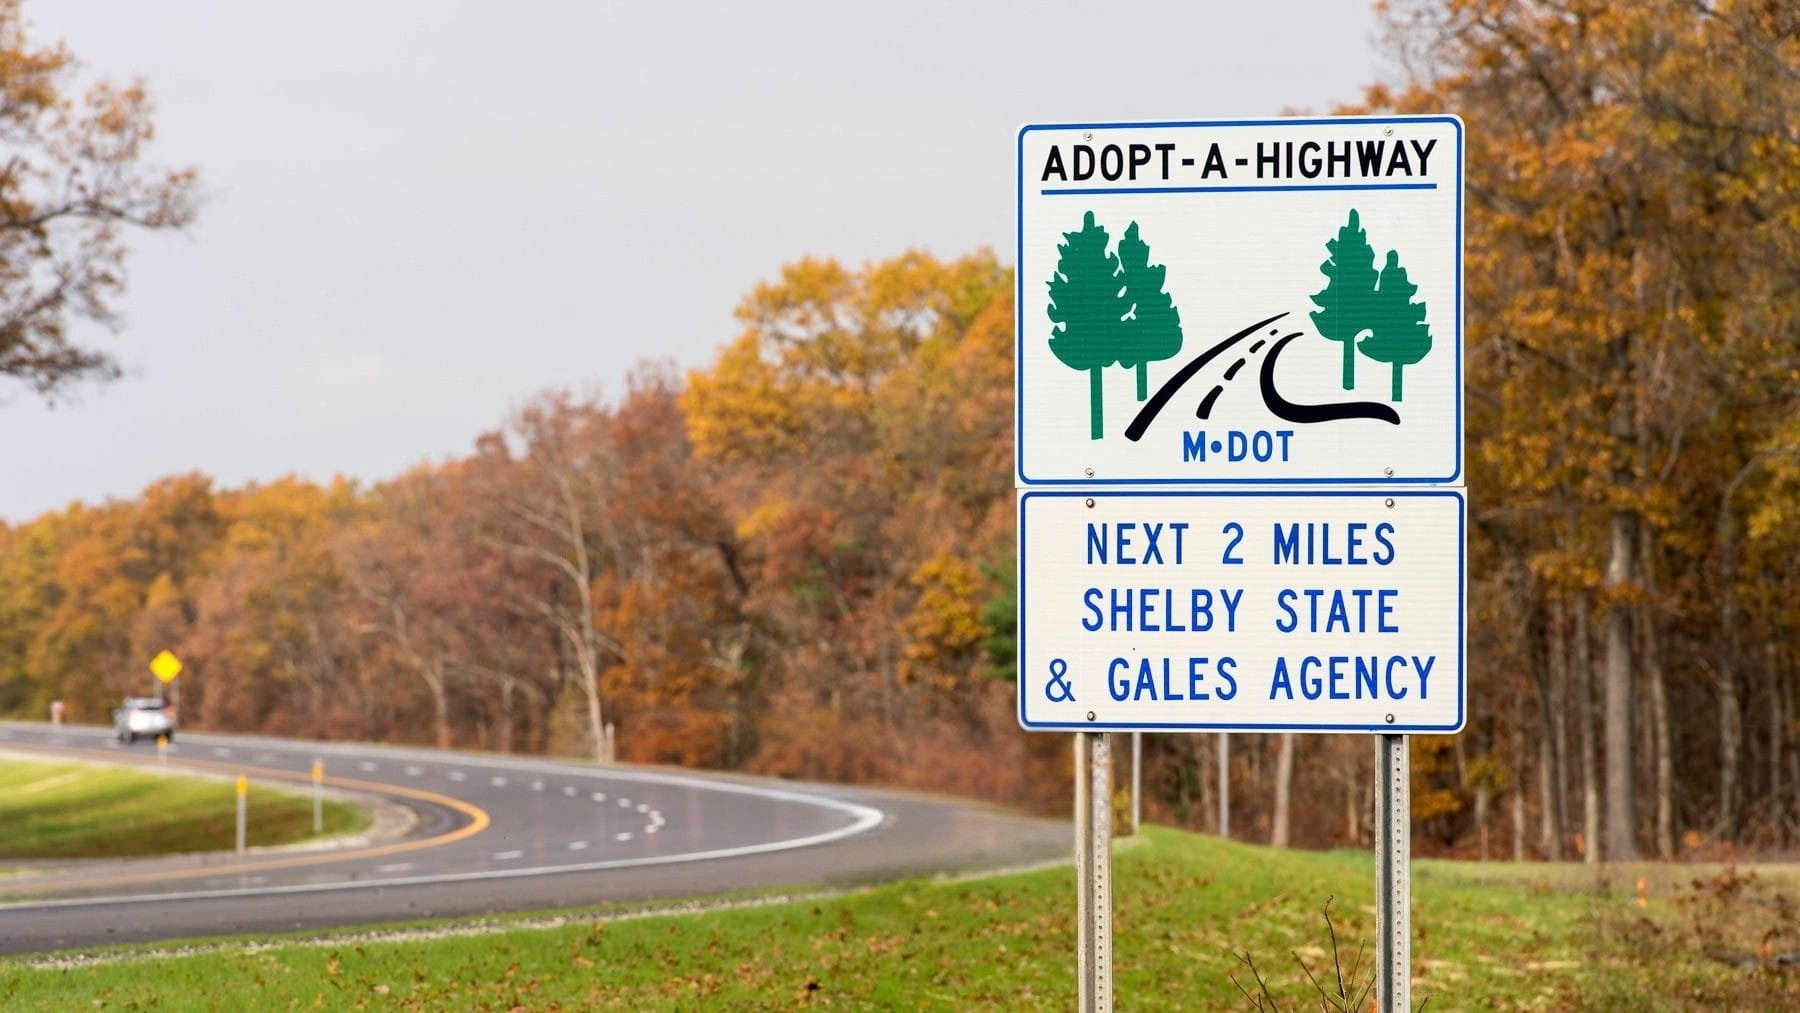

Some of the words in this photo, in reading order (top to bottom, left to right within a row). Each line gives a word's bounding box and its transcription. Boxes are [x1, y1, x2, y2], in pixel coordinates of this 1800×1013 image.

[1041, 139, 1438, 182] ADOPT-A-HIGHWAY
[1087, 522, 1189, 565] NEXT
[1221, 522, 1244, 565] 2
[1273, 522, 1395, 566] MILES
[1081, 587, 1244, 632] SHELBY
[1275, 588, 1399, 633] STATE
[1045, 658, 1076, 703] &
[1108, 656, 1238, 701] GALES
[1269, 655, 1436, 701] AGENCY
